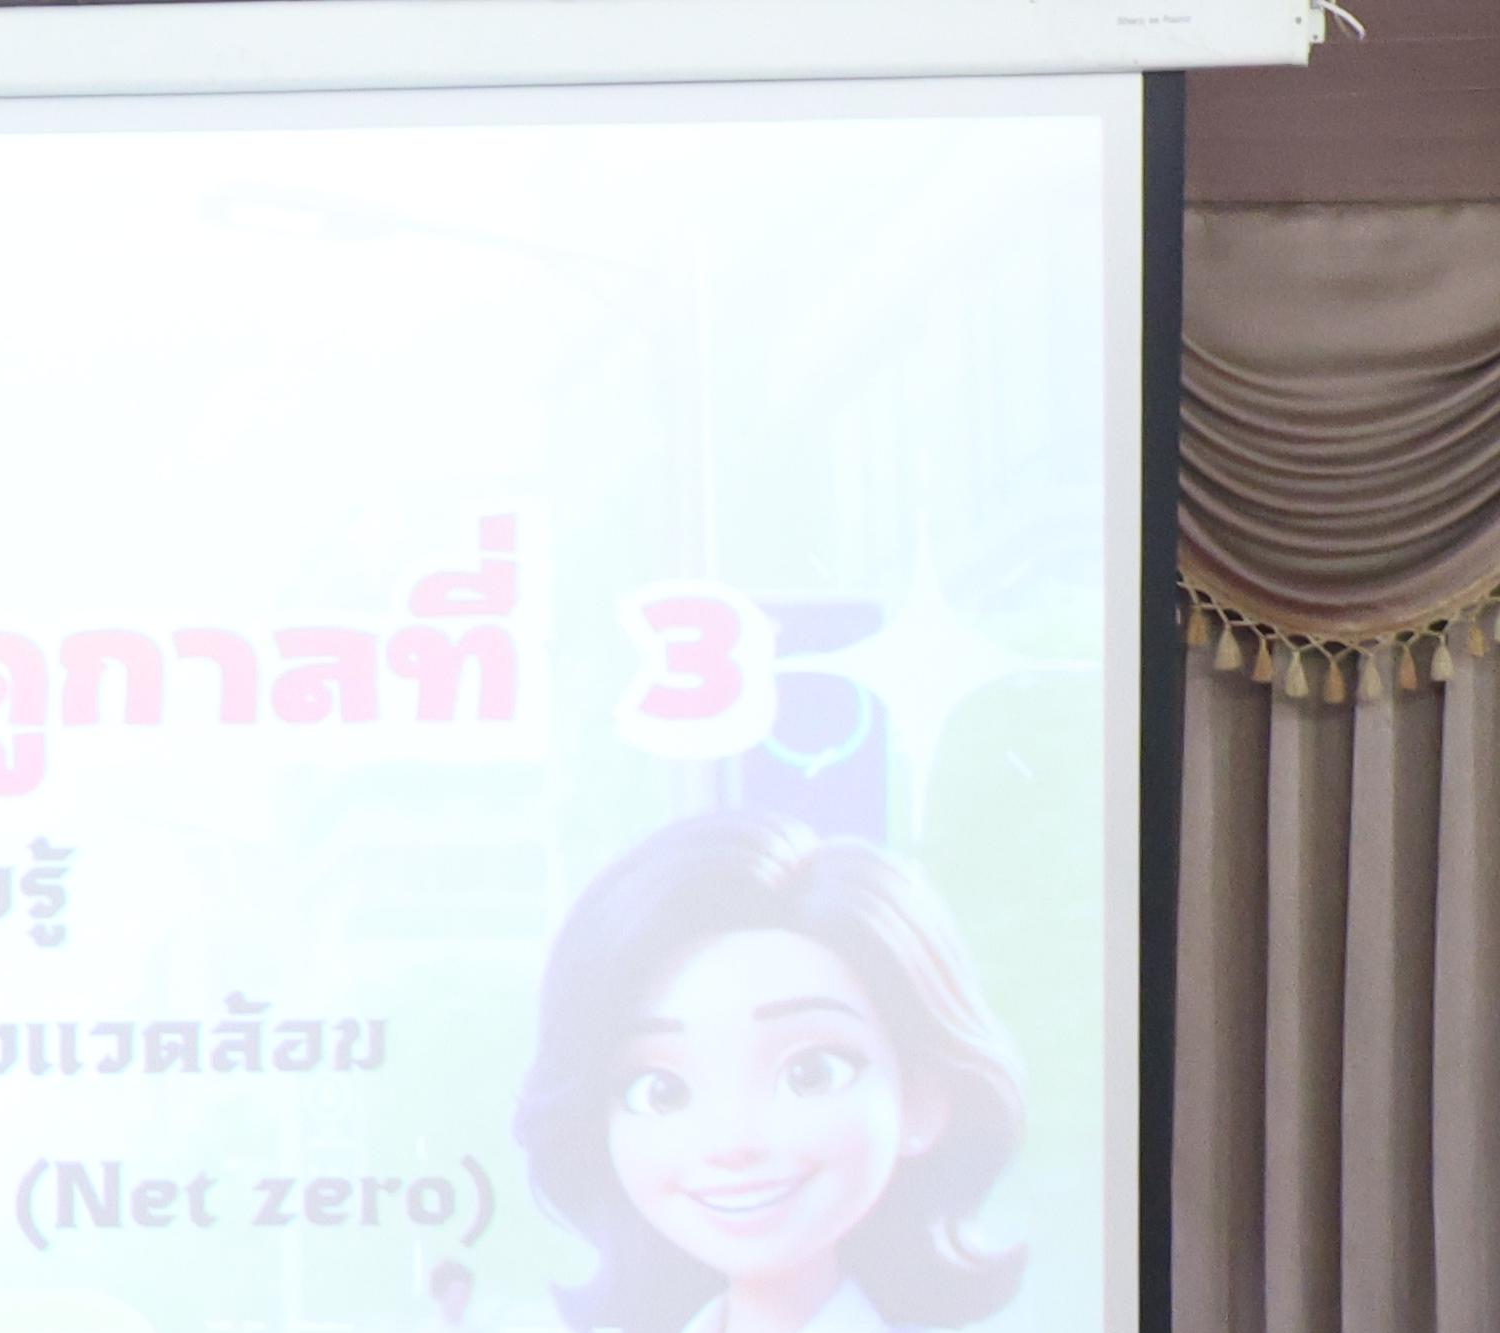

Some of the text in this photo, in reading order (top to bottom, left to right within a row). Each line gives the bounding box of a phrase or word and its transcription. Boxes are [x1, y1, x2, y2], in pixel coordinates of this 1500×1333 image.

[637, 596, 744, 722] 3
[13, 1157, 222, 1253] (Net
[250, 1153, 499, 1250] zero)
